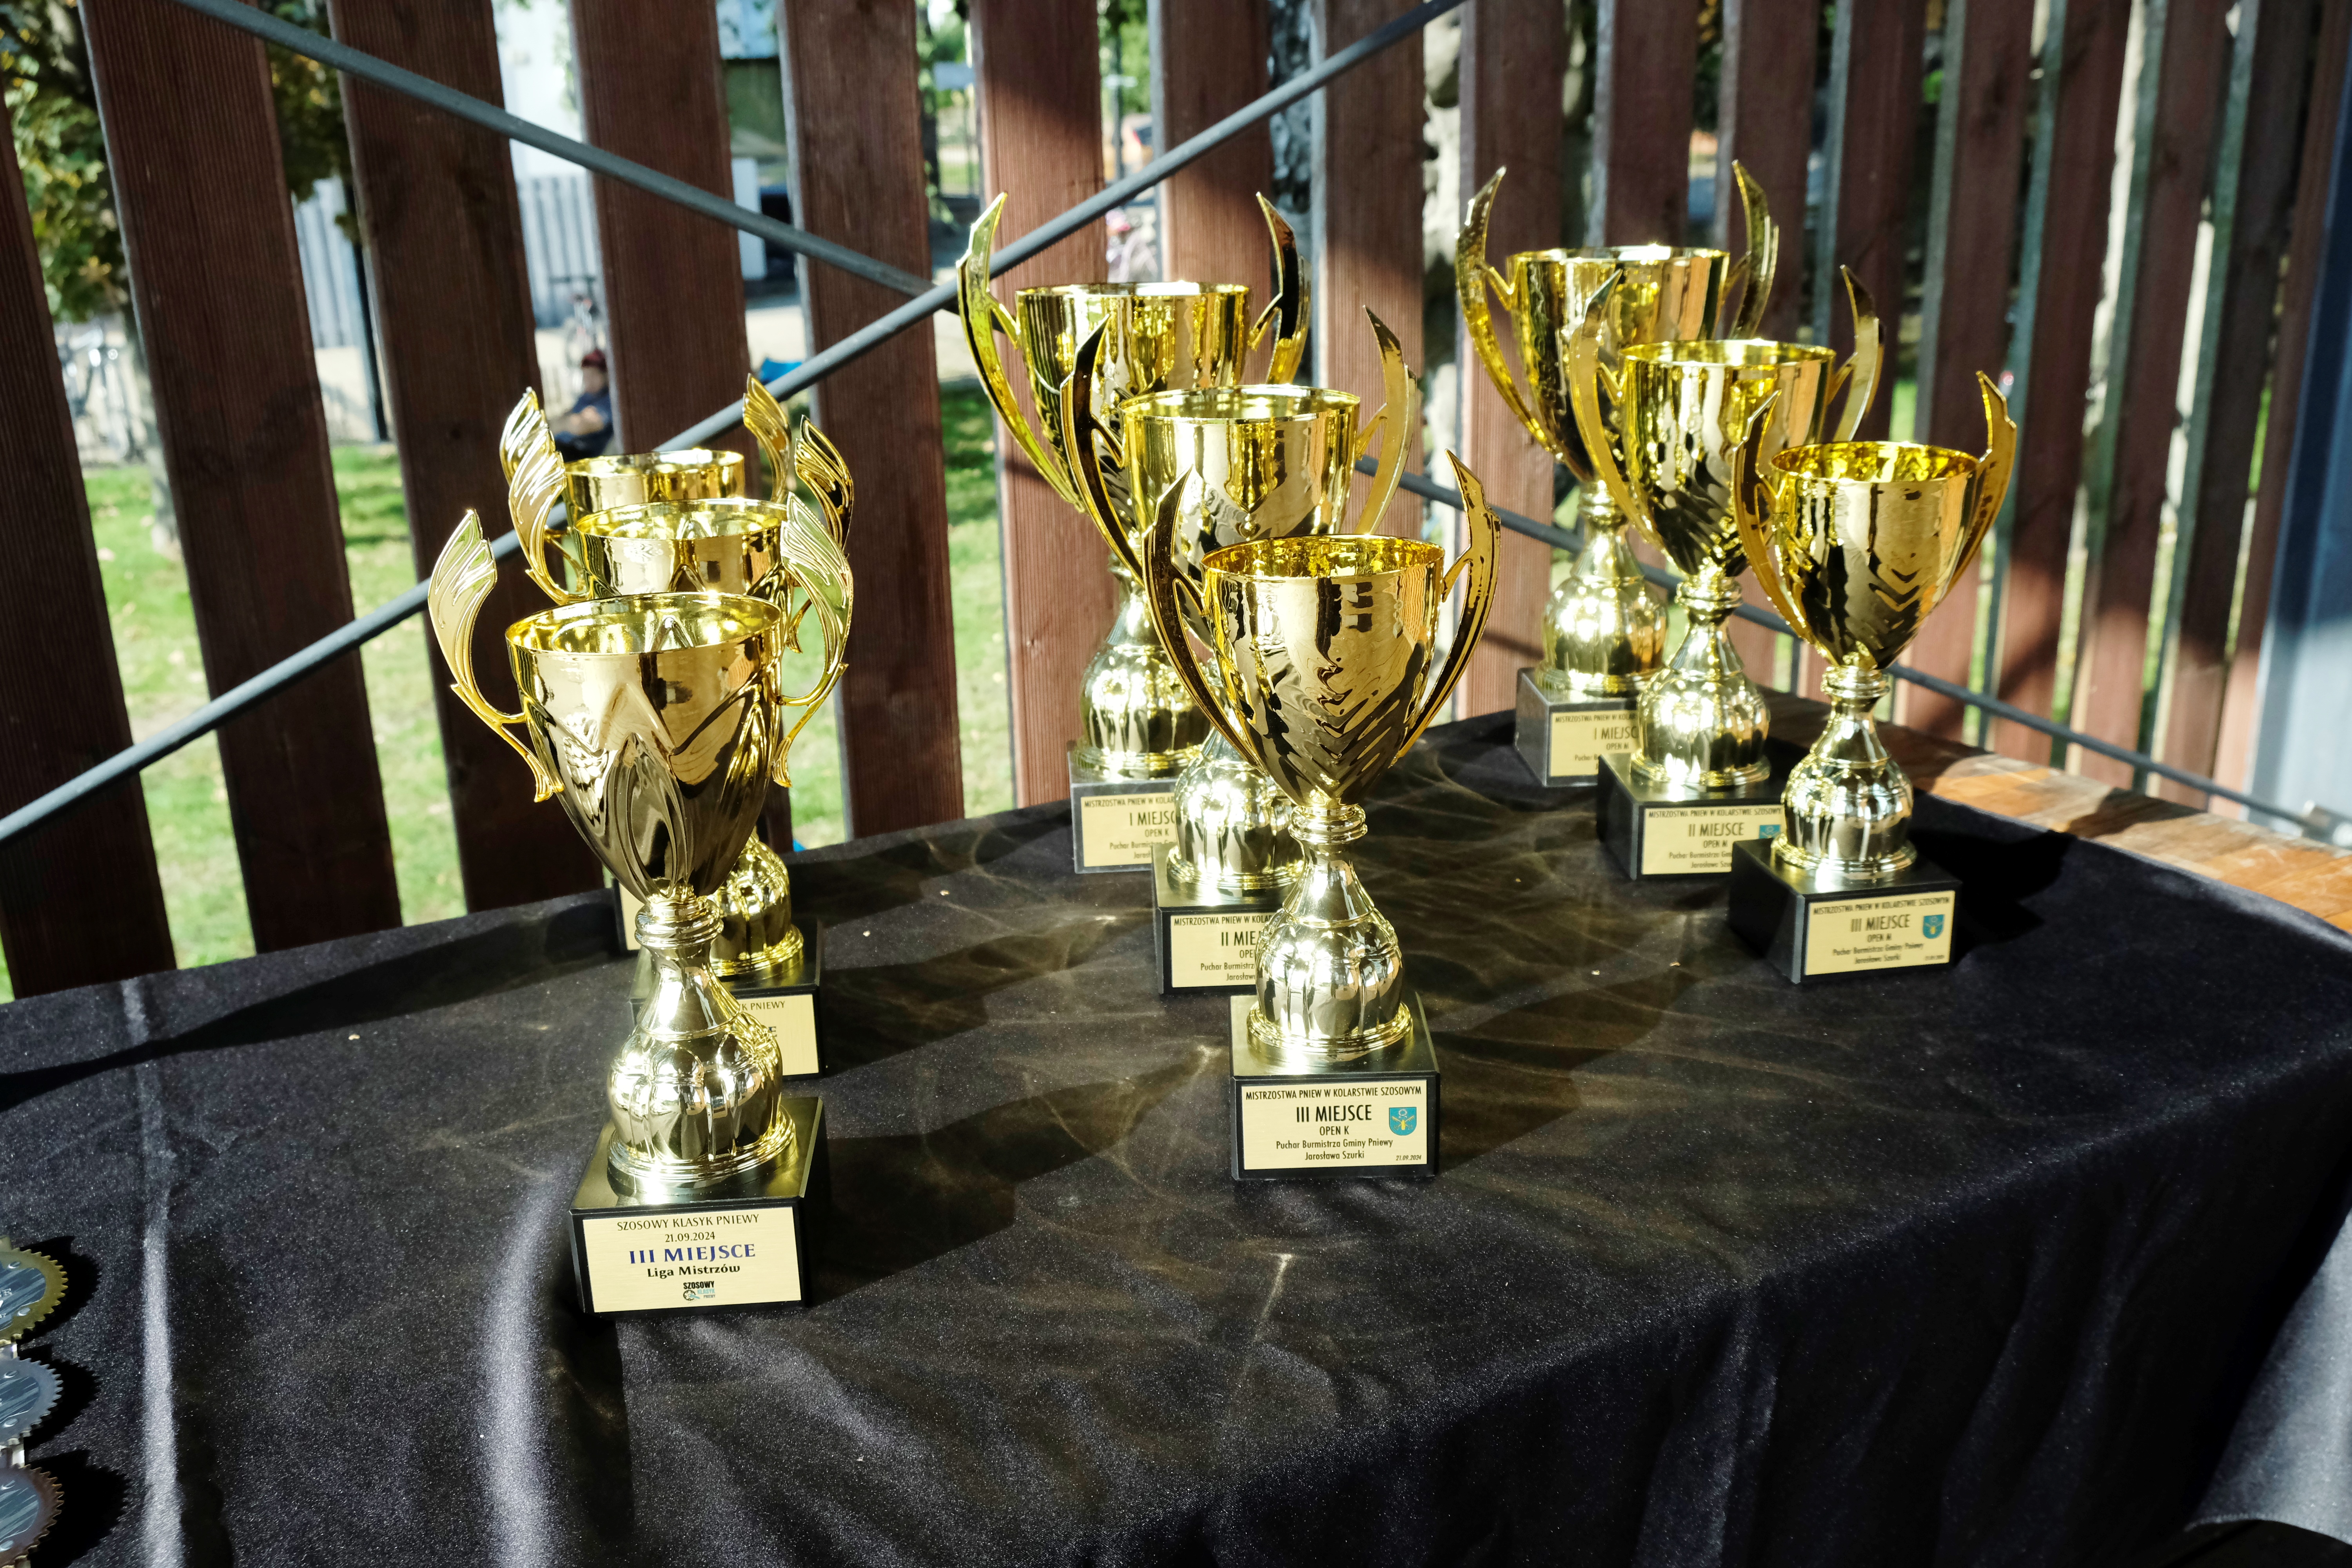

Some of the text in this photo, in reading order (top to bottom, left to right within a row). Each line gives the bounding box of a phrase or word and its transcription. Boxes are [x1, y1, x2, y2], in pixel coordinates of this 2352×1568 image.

[1594, 726, 1639, 740] I MIEJSC
[1084, 800, 1126, 808] MISTRZOSTWA
[1128, 797, 1146, 806] PNIEW
[1130, 811, 1175, 826] I MIEJSC
[1648, 809, 1688, 818] MISTRZOSTWA
[1145, 829, 1162, 837] OPEN
[1688, 822, 1744, 837] II MIEJSCE
[1703, 840, 1720, 848] OPEN
[1813, 905, 1853, 915] MISTRZOSTWA
[1174, 917, 1219, 926] MISTRZOSTWA
[1222, 916, 1242, 924] PNIEW
[1851, 914, 1911, 932] III MIEJSCE
[1221, 932, 1229, 946] II
[1867, 933, 1884, 943] OPEN
[1240, 949, 1255, 958] OPE
[1224, 961, 1255, 970] Burmistrz
[1226, 972, 1255, 981] Jarosław
[750, 1000, 786, 1011] PNIEWY
[1246, 1086, 1422, 1100] MISTRZOSTWA PNIEW W KOLARSTWIE SZOSOWYM
[1296, 1104, 1372, 1123] III MIEJSCE
[1319, 1125, 1349, 1136] OPEN K
[1276, 1138, 1393, 1150] Puchar Burmistrza Gminy Pniewy
[1305, 1150, 1365, 1161] Jarosława Szurki
[617, 1214, 759, 1232] SZOSOWY KLASYK PNIEWY
[665, 1231, 716, 1243] 21.09.2024
[629, 1243, 756, 1264] III MIEJSCE
[647, 1264, 740, 1279] Liga Mistrzów
[683, 1281, 714, 1289] SZOSOWY
